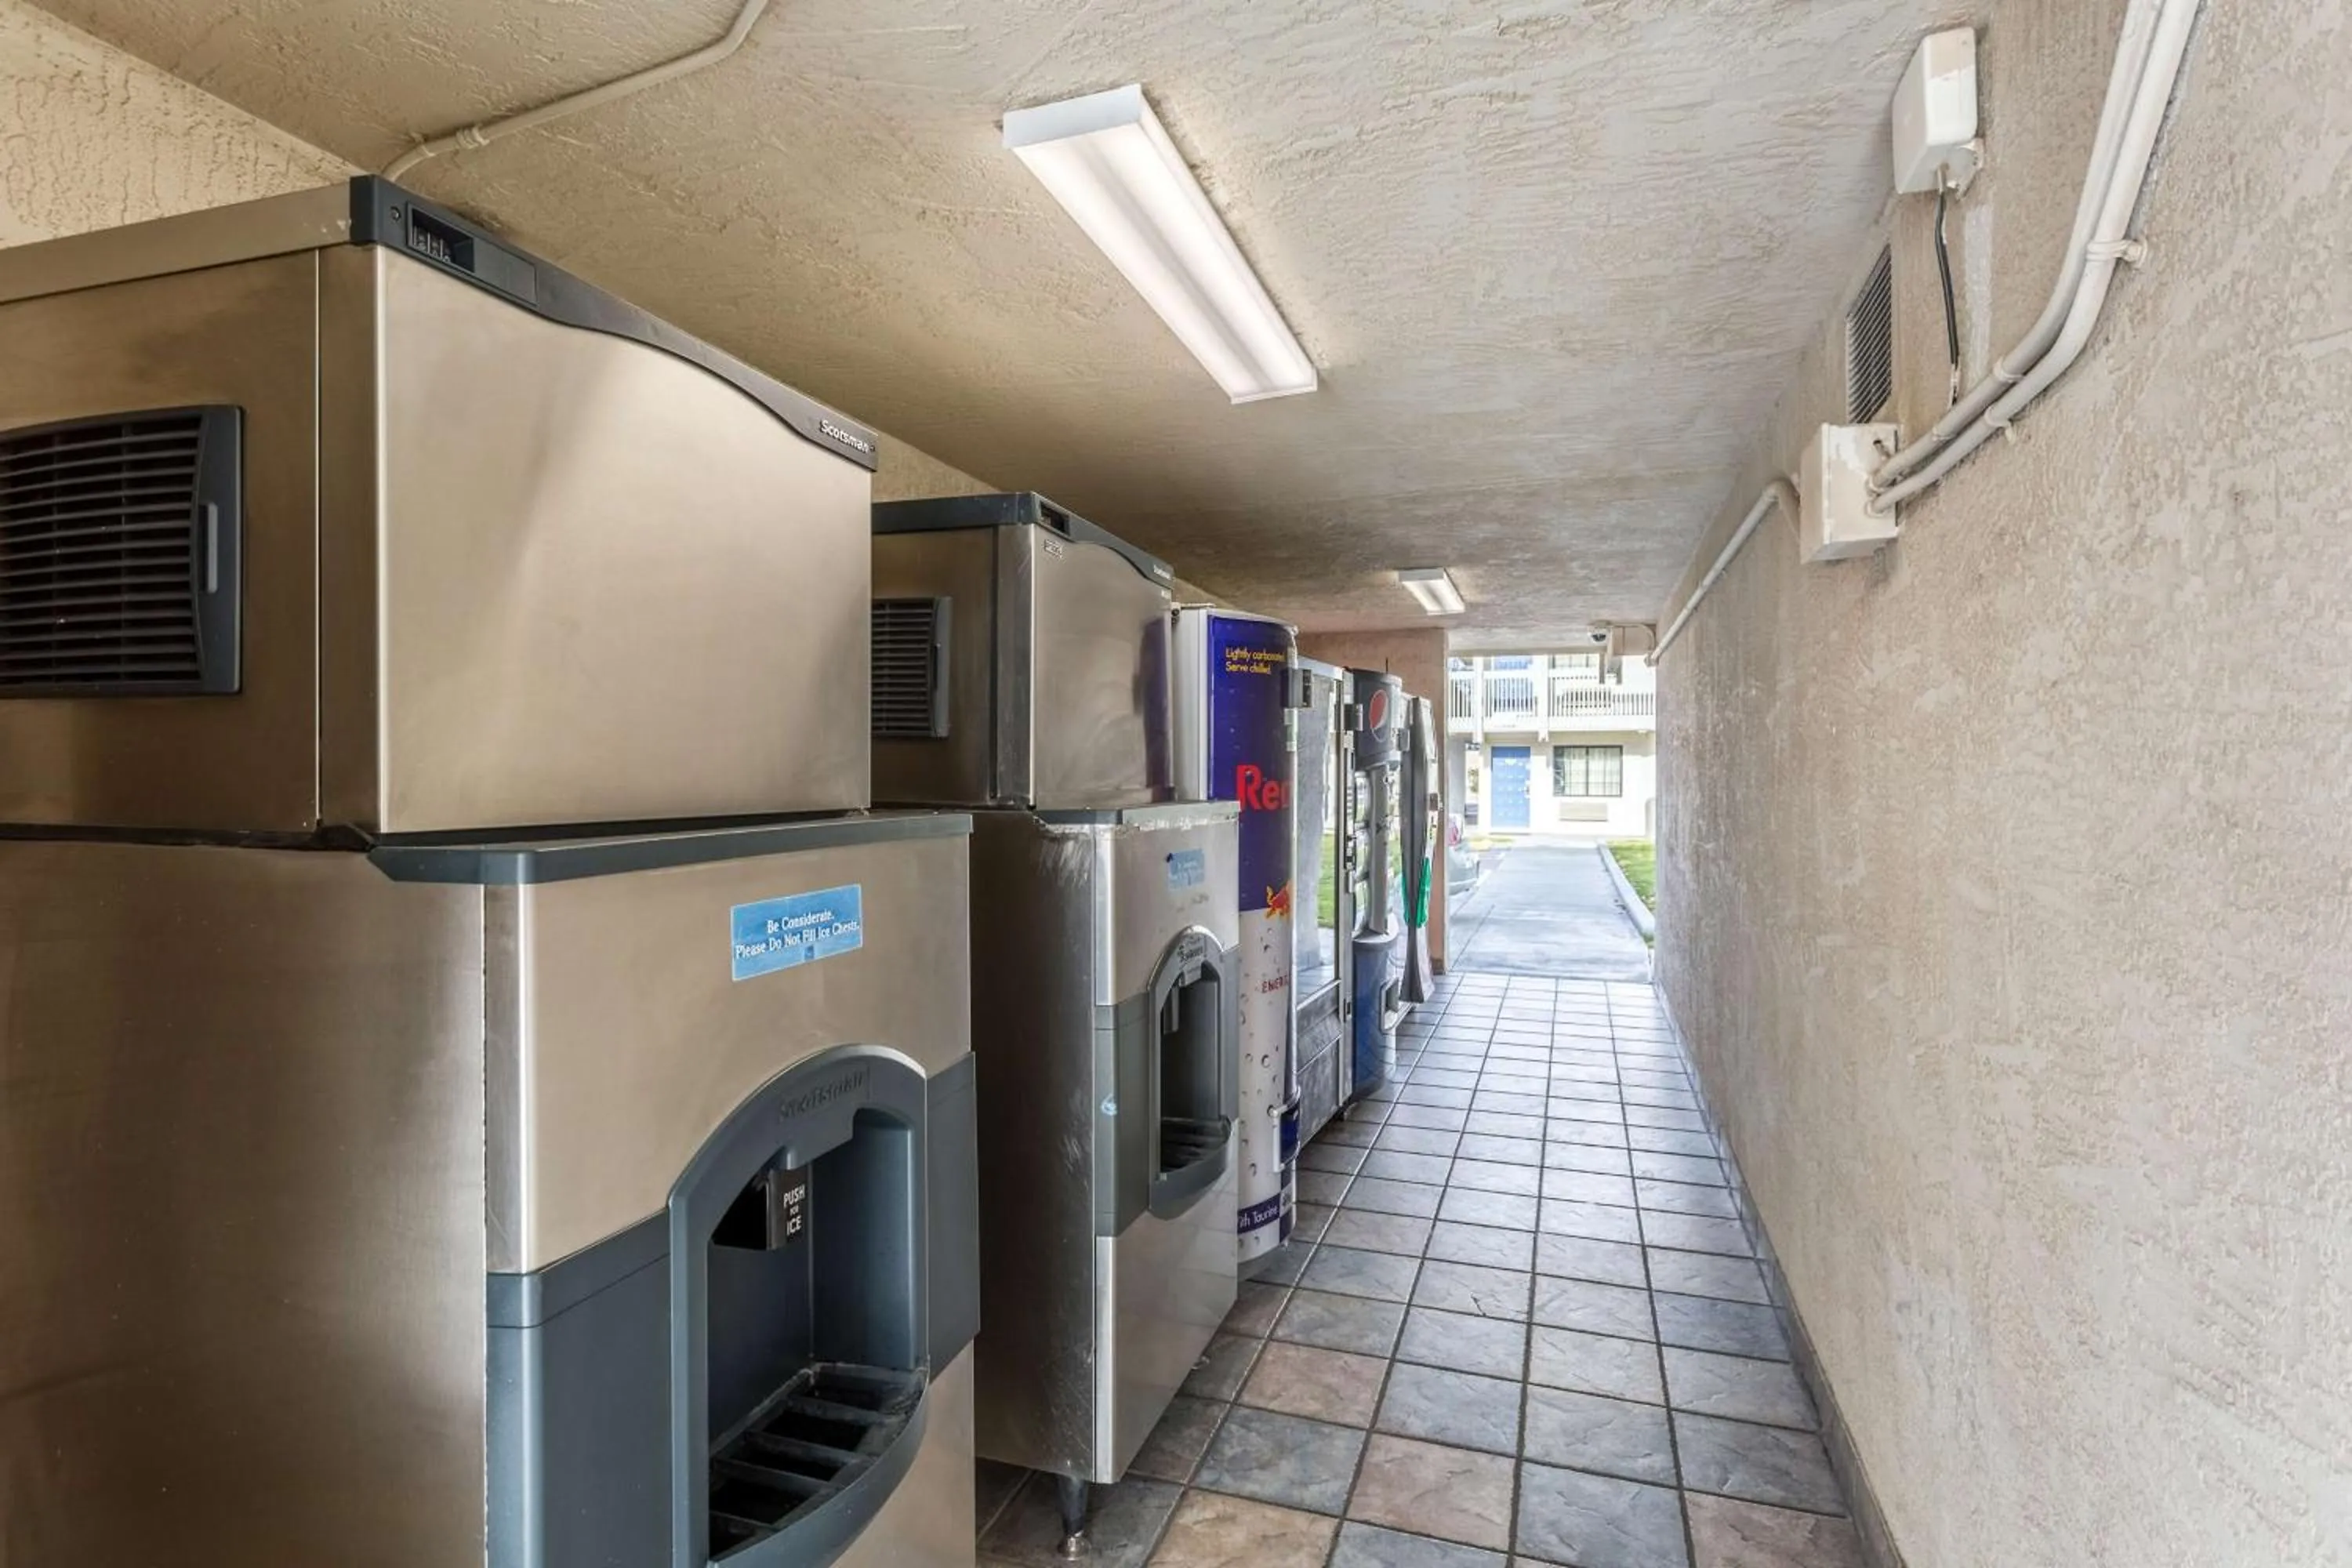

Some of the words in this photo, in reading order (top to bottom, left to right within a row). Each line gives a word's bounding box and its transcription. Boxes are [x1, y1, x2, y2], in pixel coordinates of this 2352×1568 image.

[820, 419, 869, 453] Scotsman
[767, 920, 779, 934] Be
[782, 908, 835, 931] Considerate.
[735, 942, 766, 960] Please
[768, 937, 782, 951] Do
[784, 932, 801, 948] Not
[802, 928, 816, 943] Fill
[817, 925, 830, 941] Ice
[783, 1185, 805, 1208] PUSH
[786, 1215, 801, 1236] ICE
